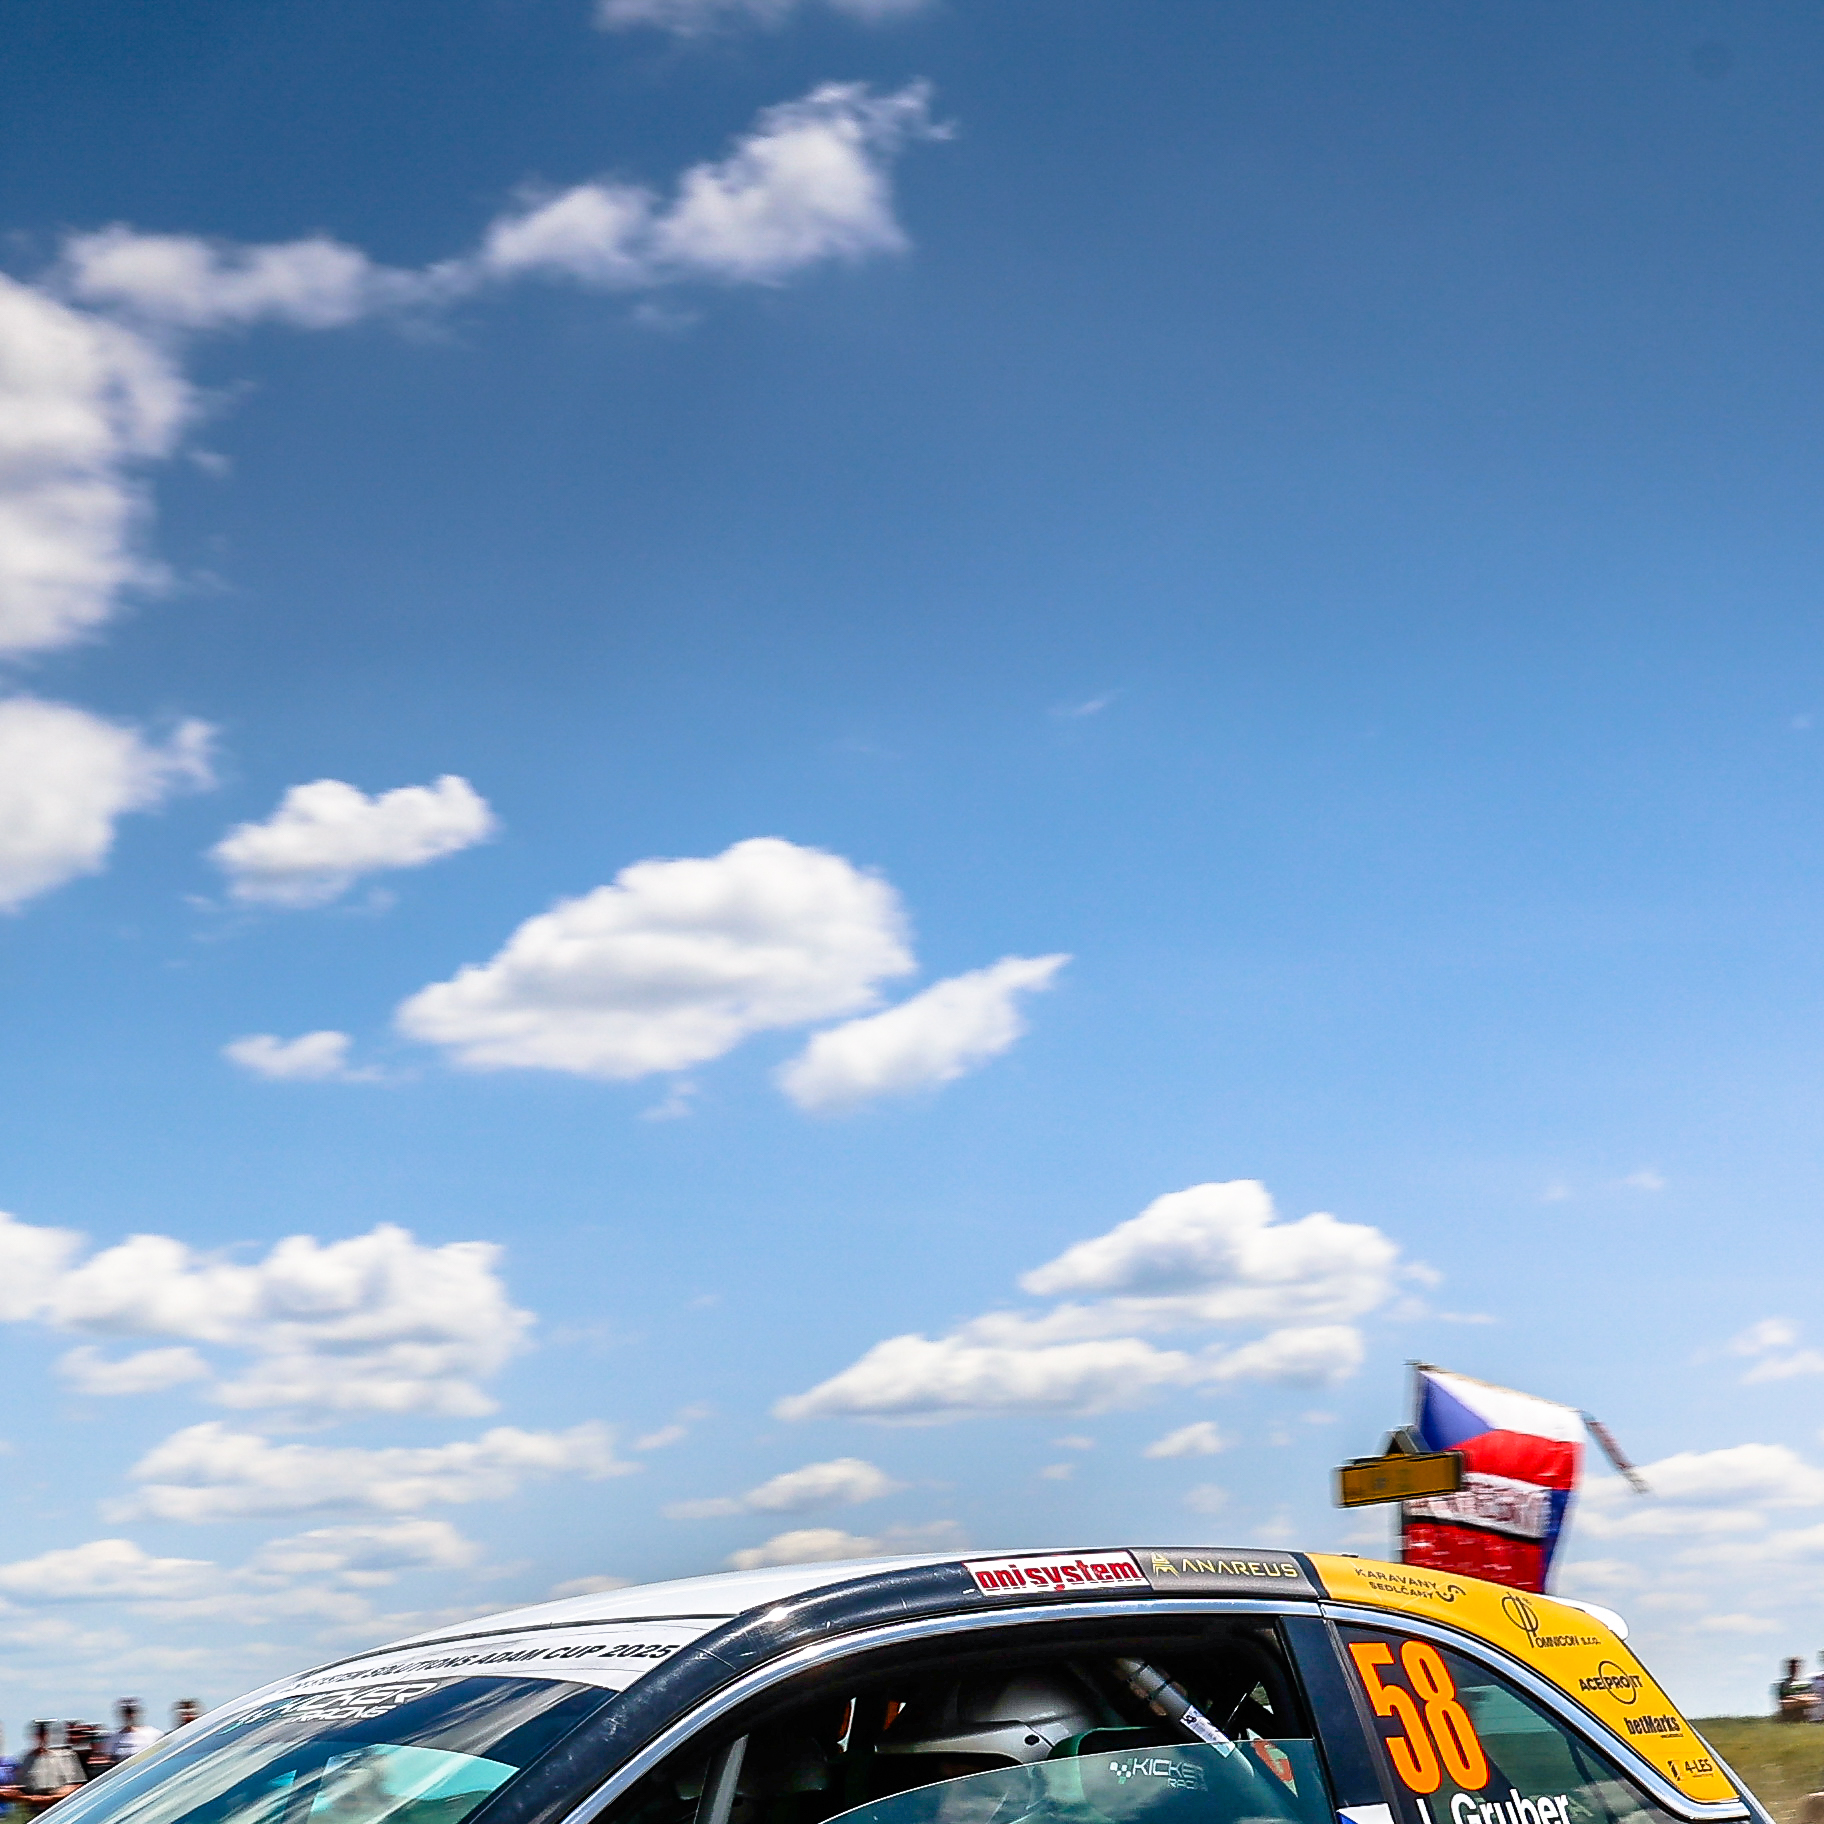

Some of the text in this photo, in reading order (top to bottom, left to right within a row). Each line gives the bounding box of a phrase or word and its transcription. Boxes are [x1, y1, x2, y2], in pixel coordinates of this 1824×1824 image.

[1182, 1558, 1298, 1578] ANAREUS
[1354, 1568, 1437, 1589] KARAVANY
[1535, 1635, 1579, 1648] OMNICON
[468, 1648, 551, 1666] ADAM
[542, 1644, 607, 1660] CUP
[603, 1643, 680, 1659] 2025
[1348, 1641, 1490, 1795] 58
[1623, 1714, 1680, 1735] betMarks
